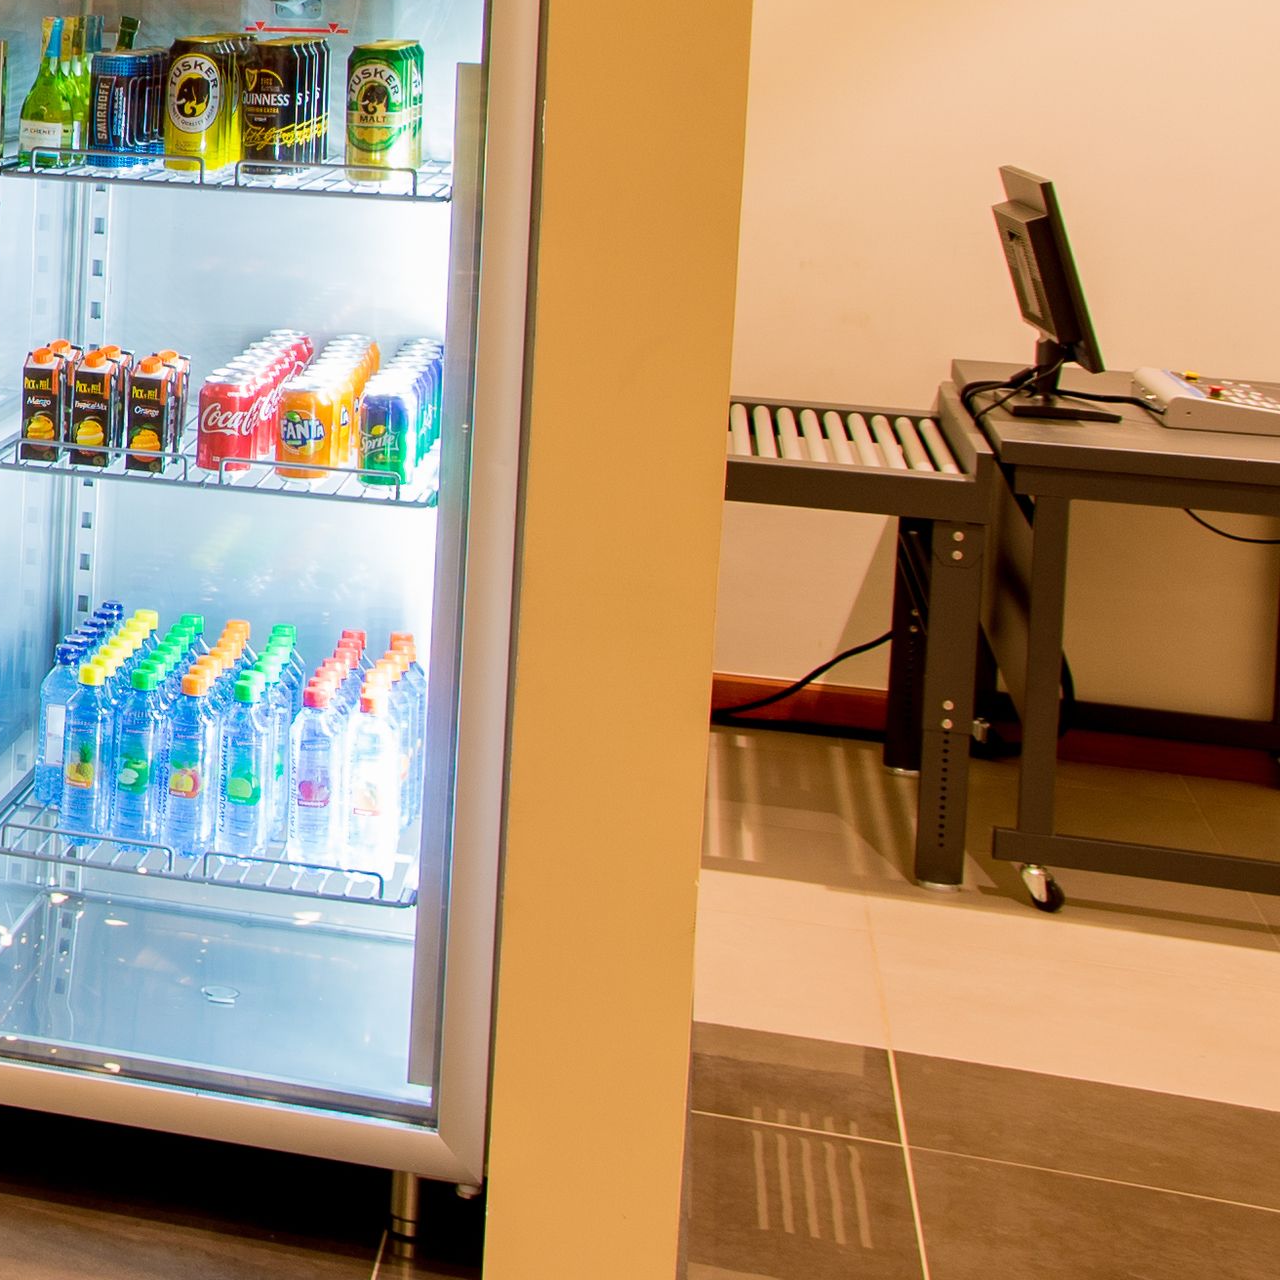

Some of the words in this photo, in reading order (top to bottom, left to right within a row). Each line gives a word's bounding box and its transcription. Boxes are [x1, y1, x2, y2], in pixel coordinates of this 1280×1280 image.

[170, 59, 219, 89] TUSKER
[349, 67, 400, 96] TUSKER
[96, 82, 110, 140] SMIRNOFF
[360, 115, 386, 124] MALT
[281, 419, 325, 440] FANTA
[360, 432, 395, 452] Sprite
